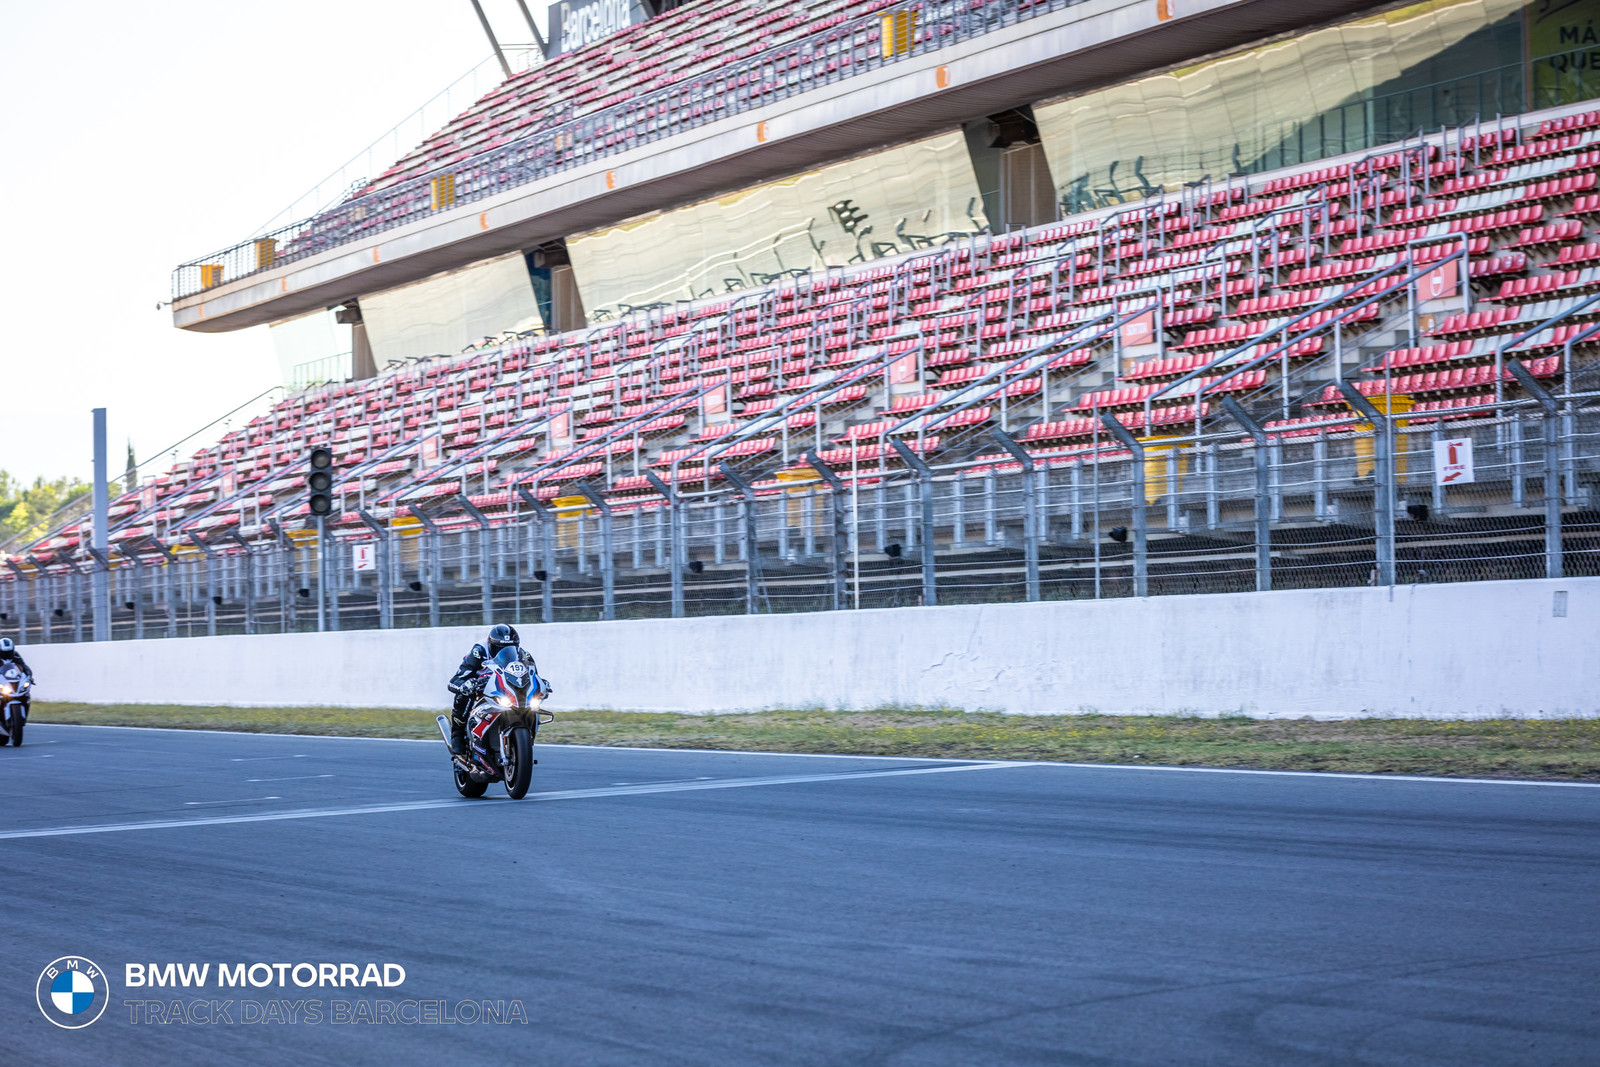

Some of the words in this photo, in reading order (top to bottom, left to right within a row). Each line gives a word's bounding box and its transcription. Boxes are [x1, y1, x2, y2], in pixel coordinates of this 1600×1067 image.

[561, 0, 631, 52] Barcelona
[1559, 19, 1600, 44] MÁ
[510, 664, 524, 672] 197
